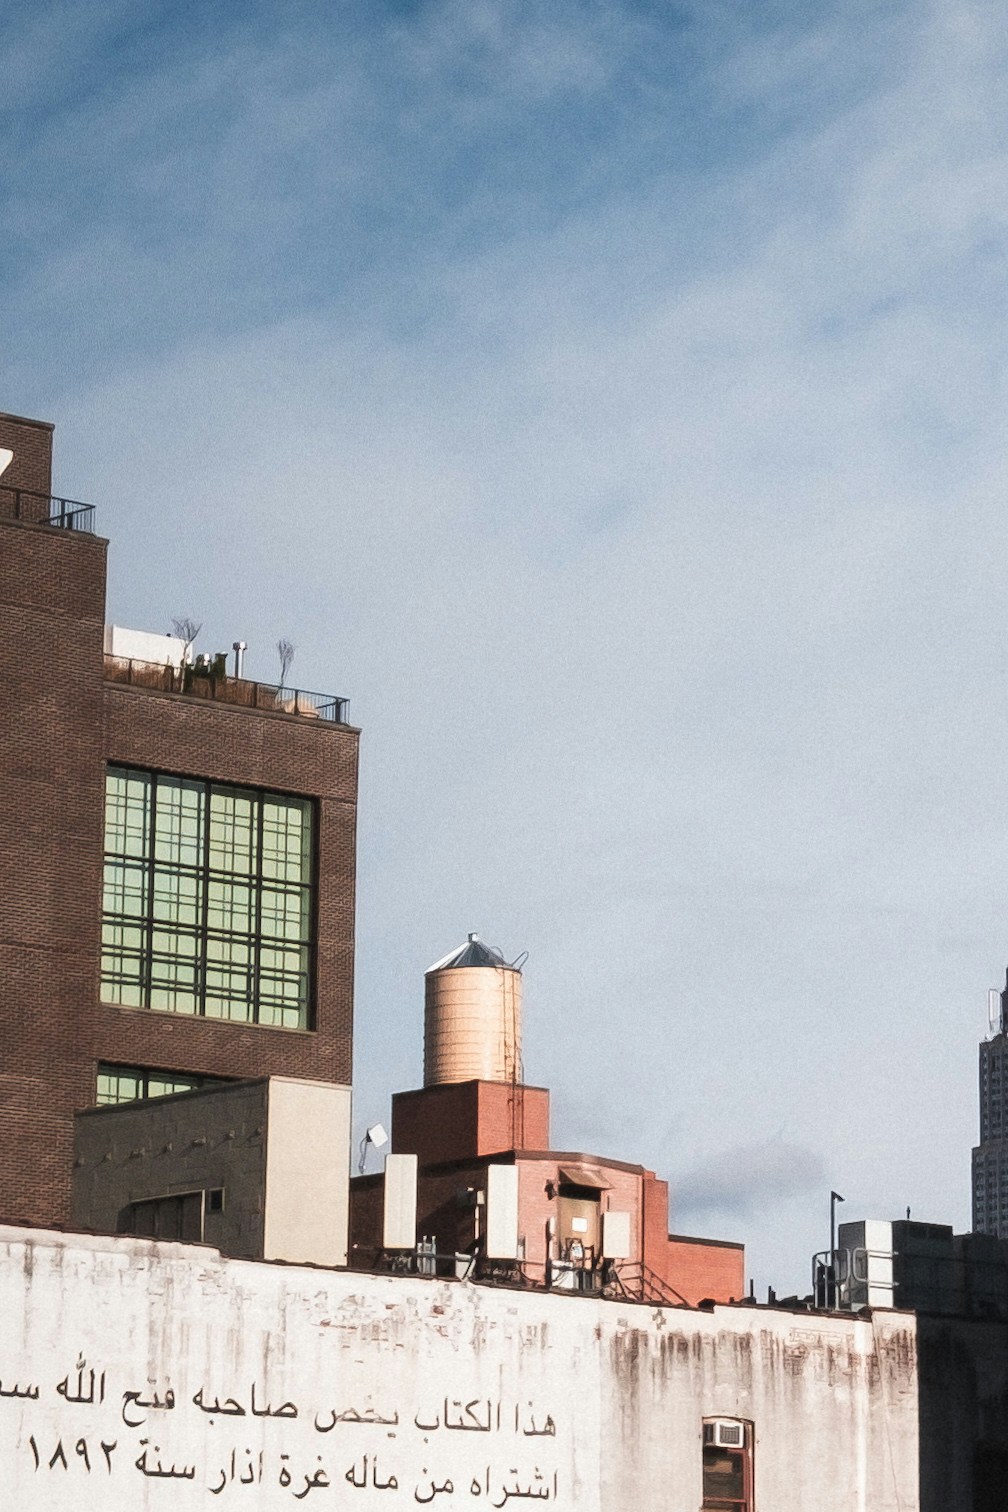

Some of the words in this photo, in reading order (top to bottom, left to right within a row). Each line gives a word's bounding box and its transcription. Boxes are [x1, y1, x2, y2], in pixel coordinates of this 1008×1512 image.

[55, 1351, 106, 1405] الله
[121, 1375, 176, 1429] فتح
[192, 1381, 299, 1426] صاحبه
[313, 1394, 399, 1440] يخص
[412, 1396, 501, 1444] الكتاب
[514, 1400, 557, 1438] هذا
[28, 1434, 118, 1476] ١٨٩٢
[134, 1437, 196, 1480] سنة
[207, 1447, 264, 1495] اذار
[278, 1453, 331, 1500] غرة
[413, 1467, 455, 1504] من
[469, 1465, 558, 1509] اشتراه
